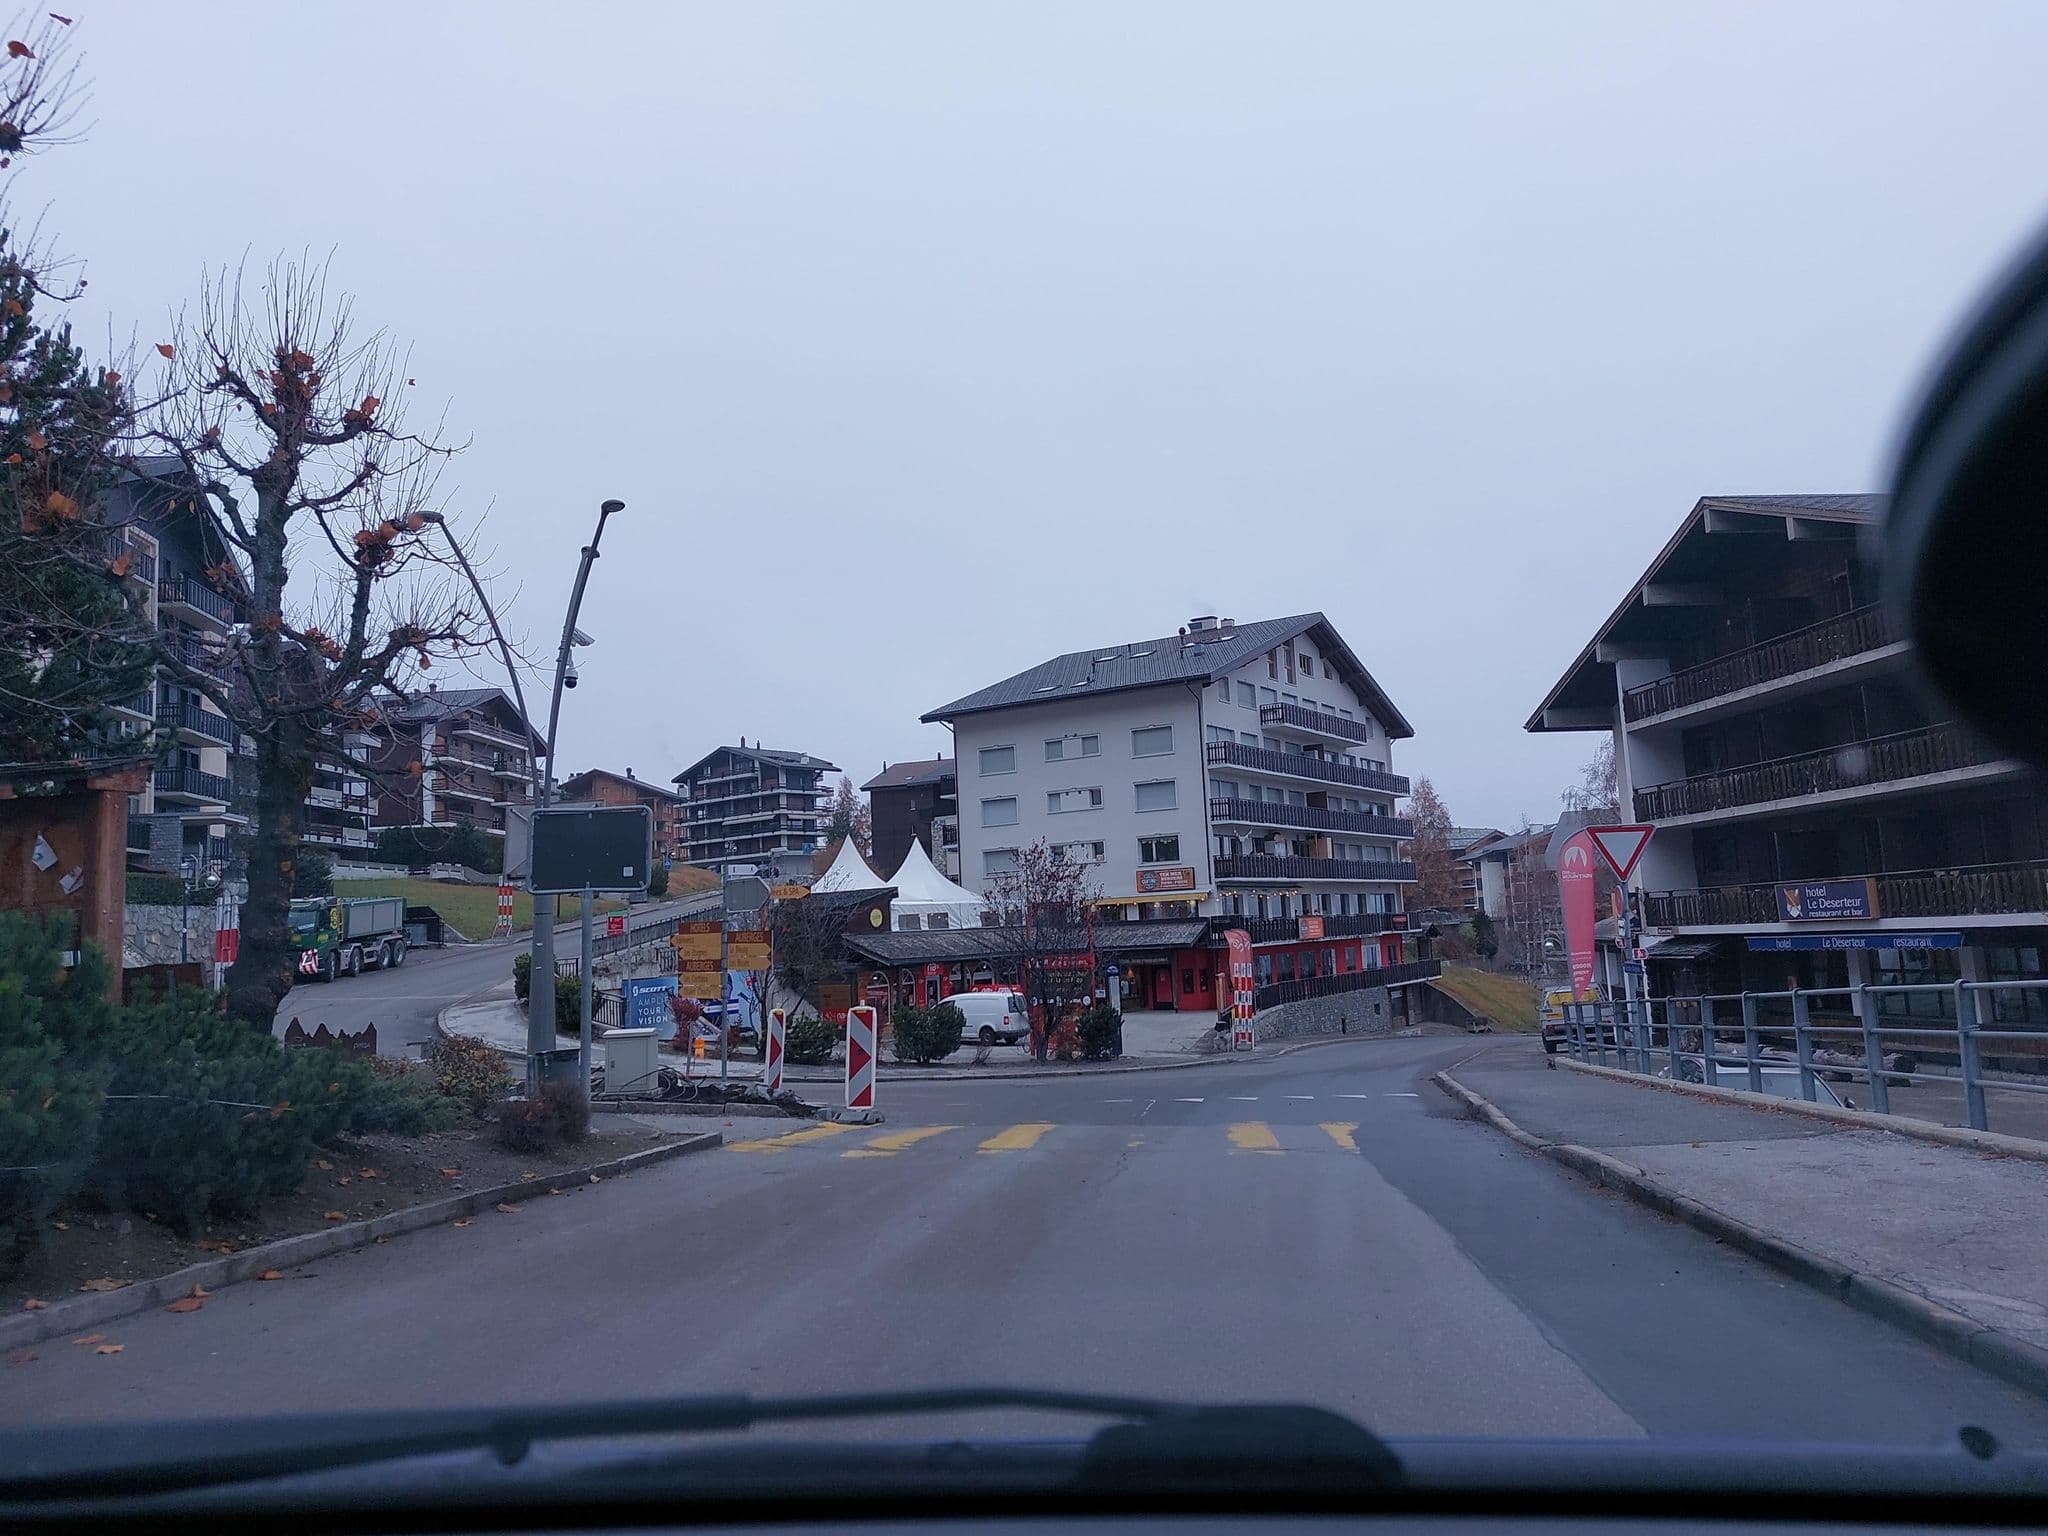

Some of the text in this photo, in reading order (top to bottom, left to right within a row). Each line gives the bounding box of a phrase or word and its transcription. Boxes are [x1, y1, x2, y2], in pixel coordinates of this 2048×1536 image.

[1805, 886, 1827, 898] hotel
[1807, 900, 1819, 909] Le
[1808, 910, 1842, 918] restaurant
[1851, 908, 1863, 916] bar
[1775, 938, 1792, 948] hotel
[1822, 937, 1831, 948] Le
[1893, 937, 1932, 947] restaurant
[639, 986, 667, 994] SCOTT
[638, 1006, 661, 1016] YOUR
[638, 1015, 668, 1025] VISION
